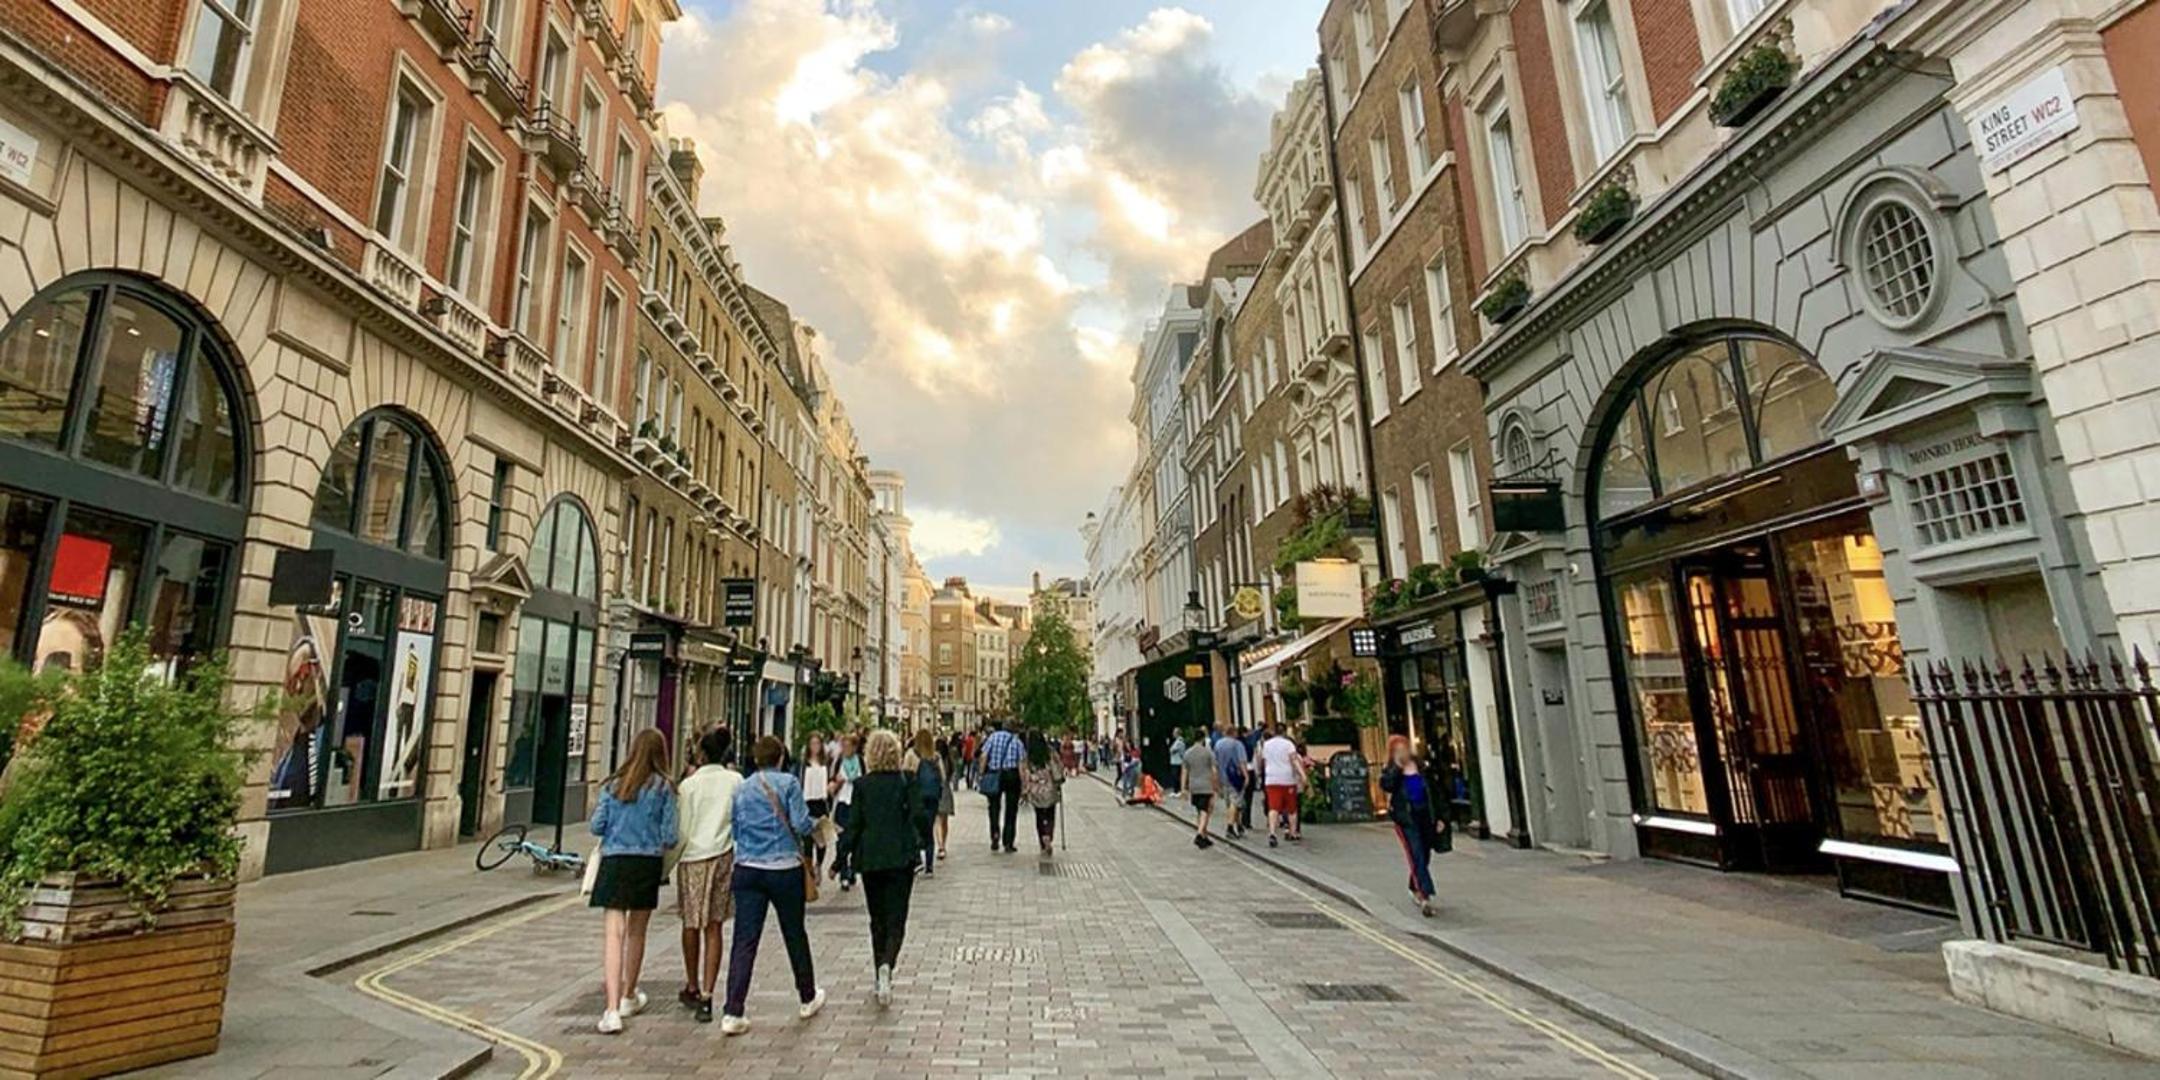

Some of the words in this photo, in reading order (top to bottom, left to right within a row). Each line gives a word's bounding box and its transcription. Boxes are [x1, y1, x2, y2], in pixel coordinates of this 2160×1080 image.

[1980, 105, 2010, 134] KING
[1986, 115, 2028, 152] STREET
[2031, 96, 2062, 123] WC2
[1908, 442, 1951, 464] MONRO
